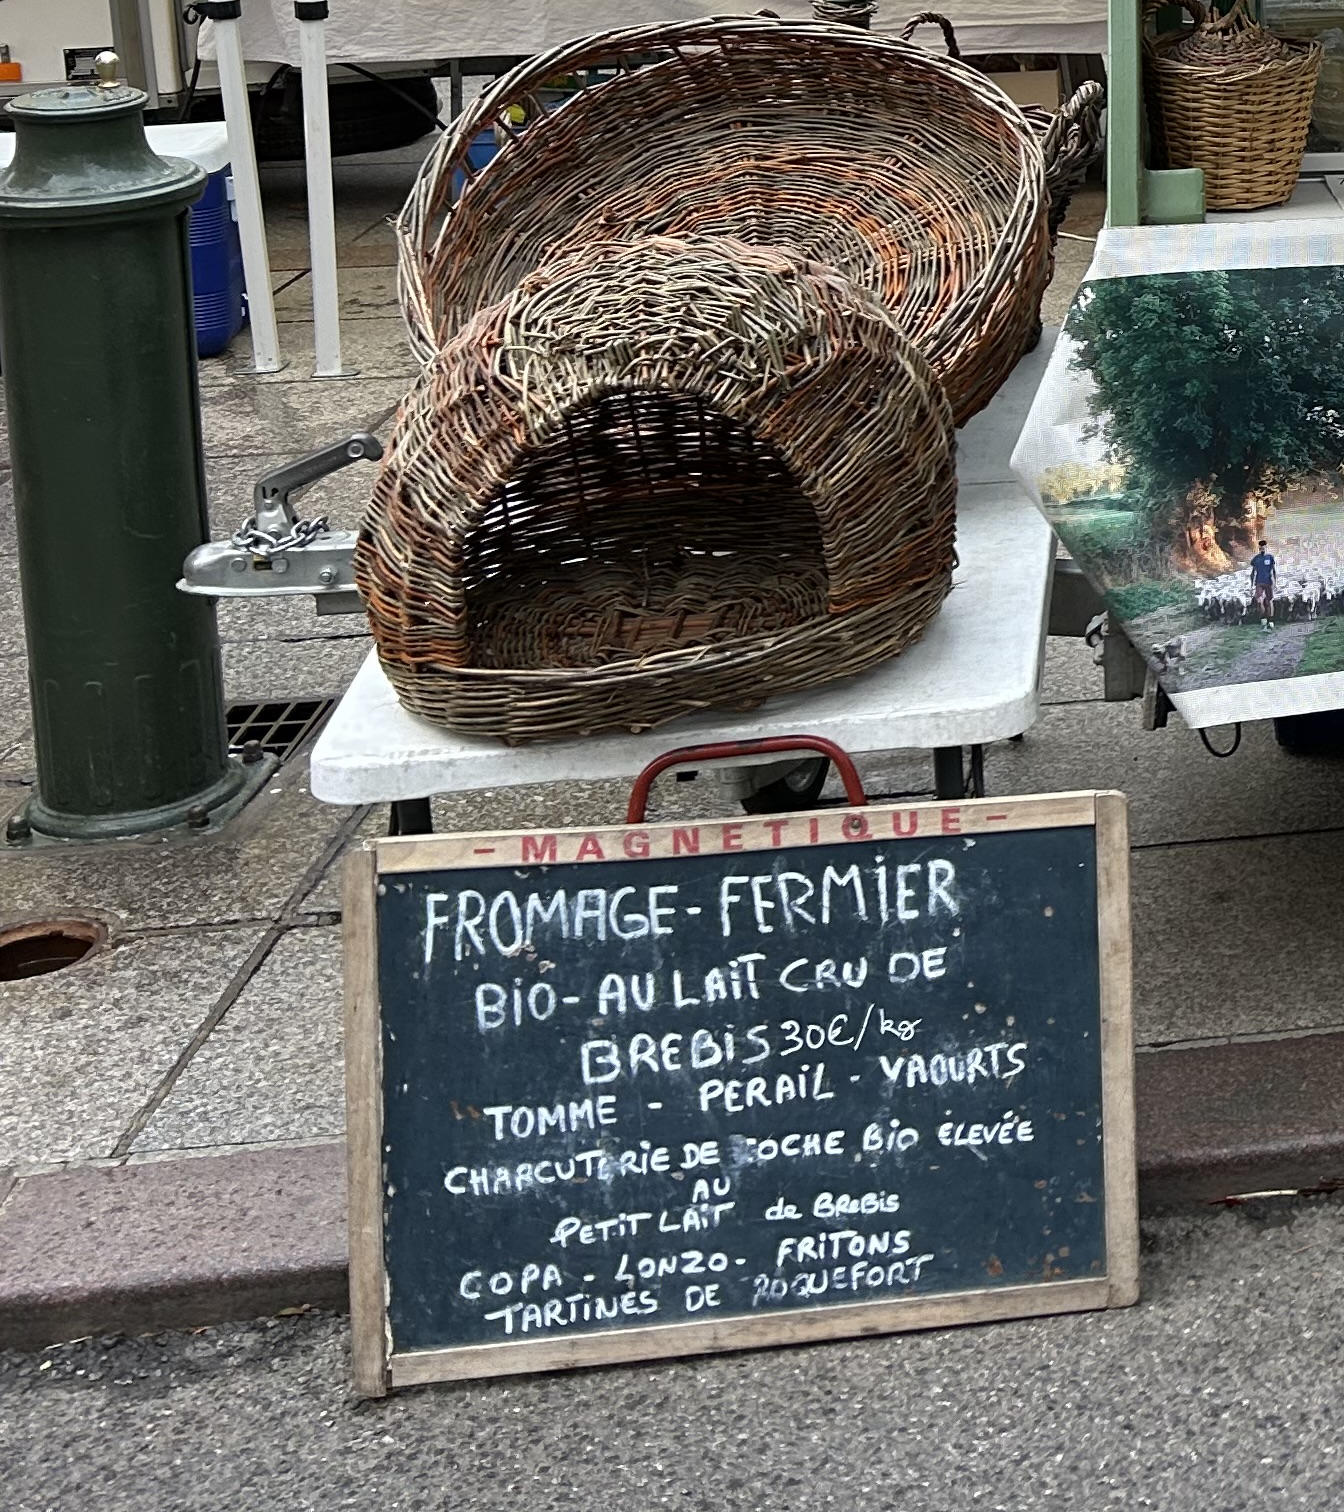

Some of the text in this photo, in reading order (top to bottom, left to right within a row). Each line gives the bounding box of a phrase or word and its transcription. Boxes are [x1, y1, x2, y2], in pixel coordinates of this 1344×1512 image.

[521, 809, 965, 863] MAGNETIQUE
[779, 958, 870, 995] CRU
[889, 947, 949, 983] DE
[483, 1096, 617, 1141] TOMME
[680, 1141, 721, 1169] DE
[692, 1177, 731, 1203] AU
[765, 1198, 803, 1220] de
[459, 1264, 563, 1299] COPA
[685, 1284, 721, 1312] DE
